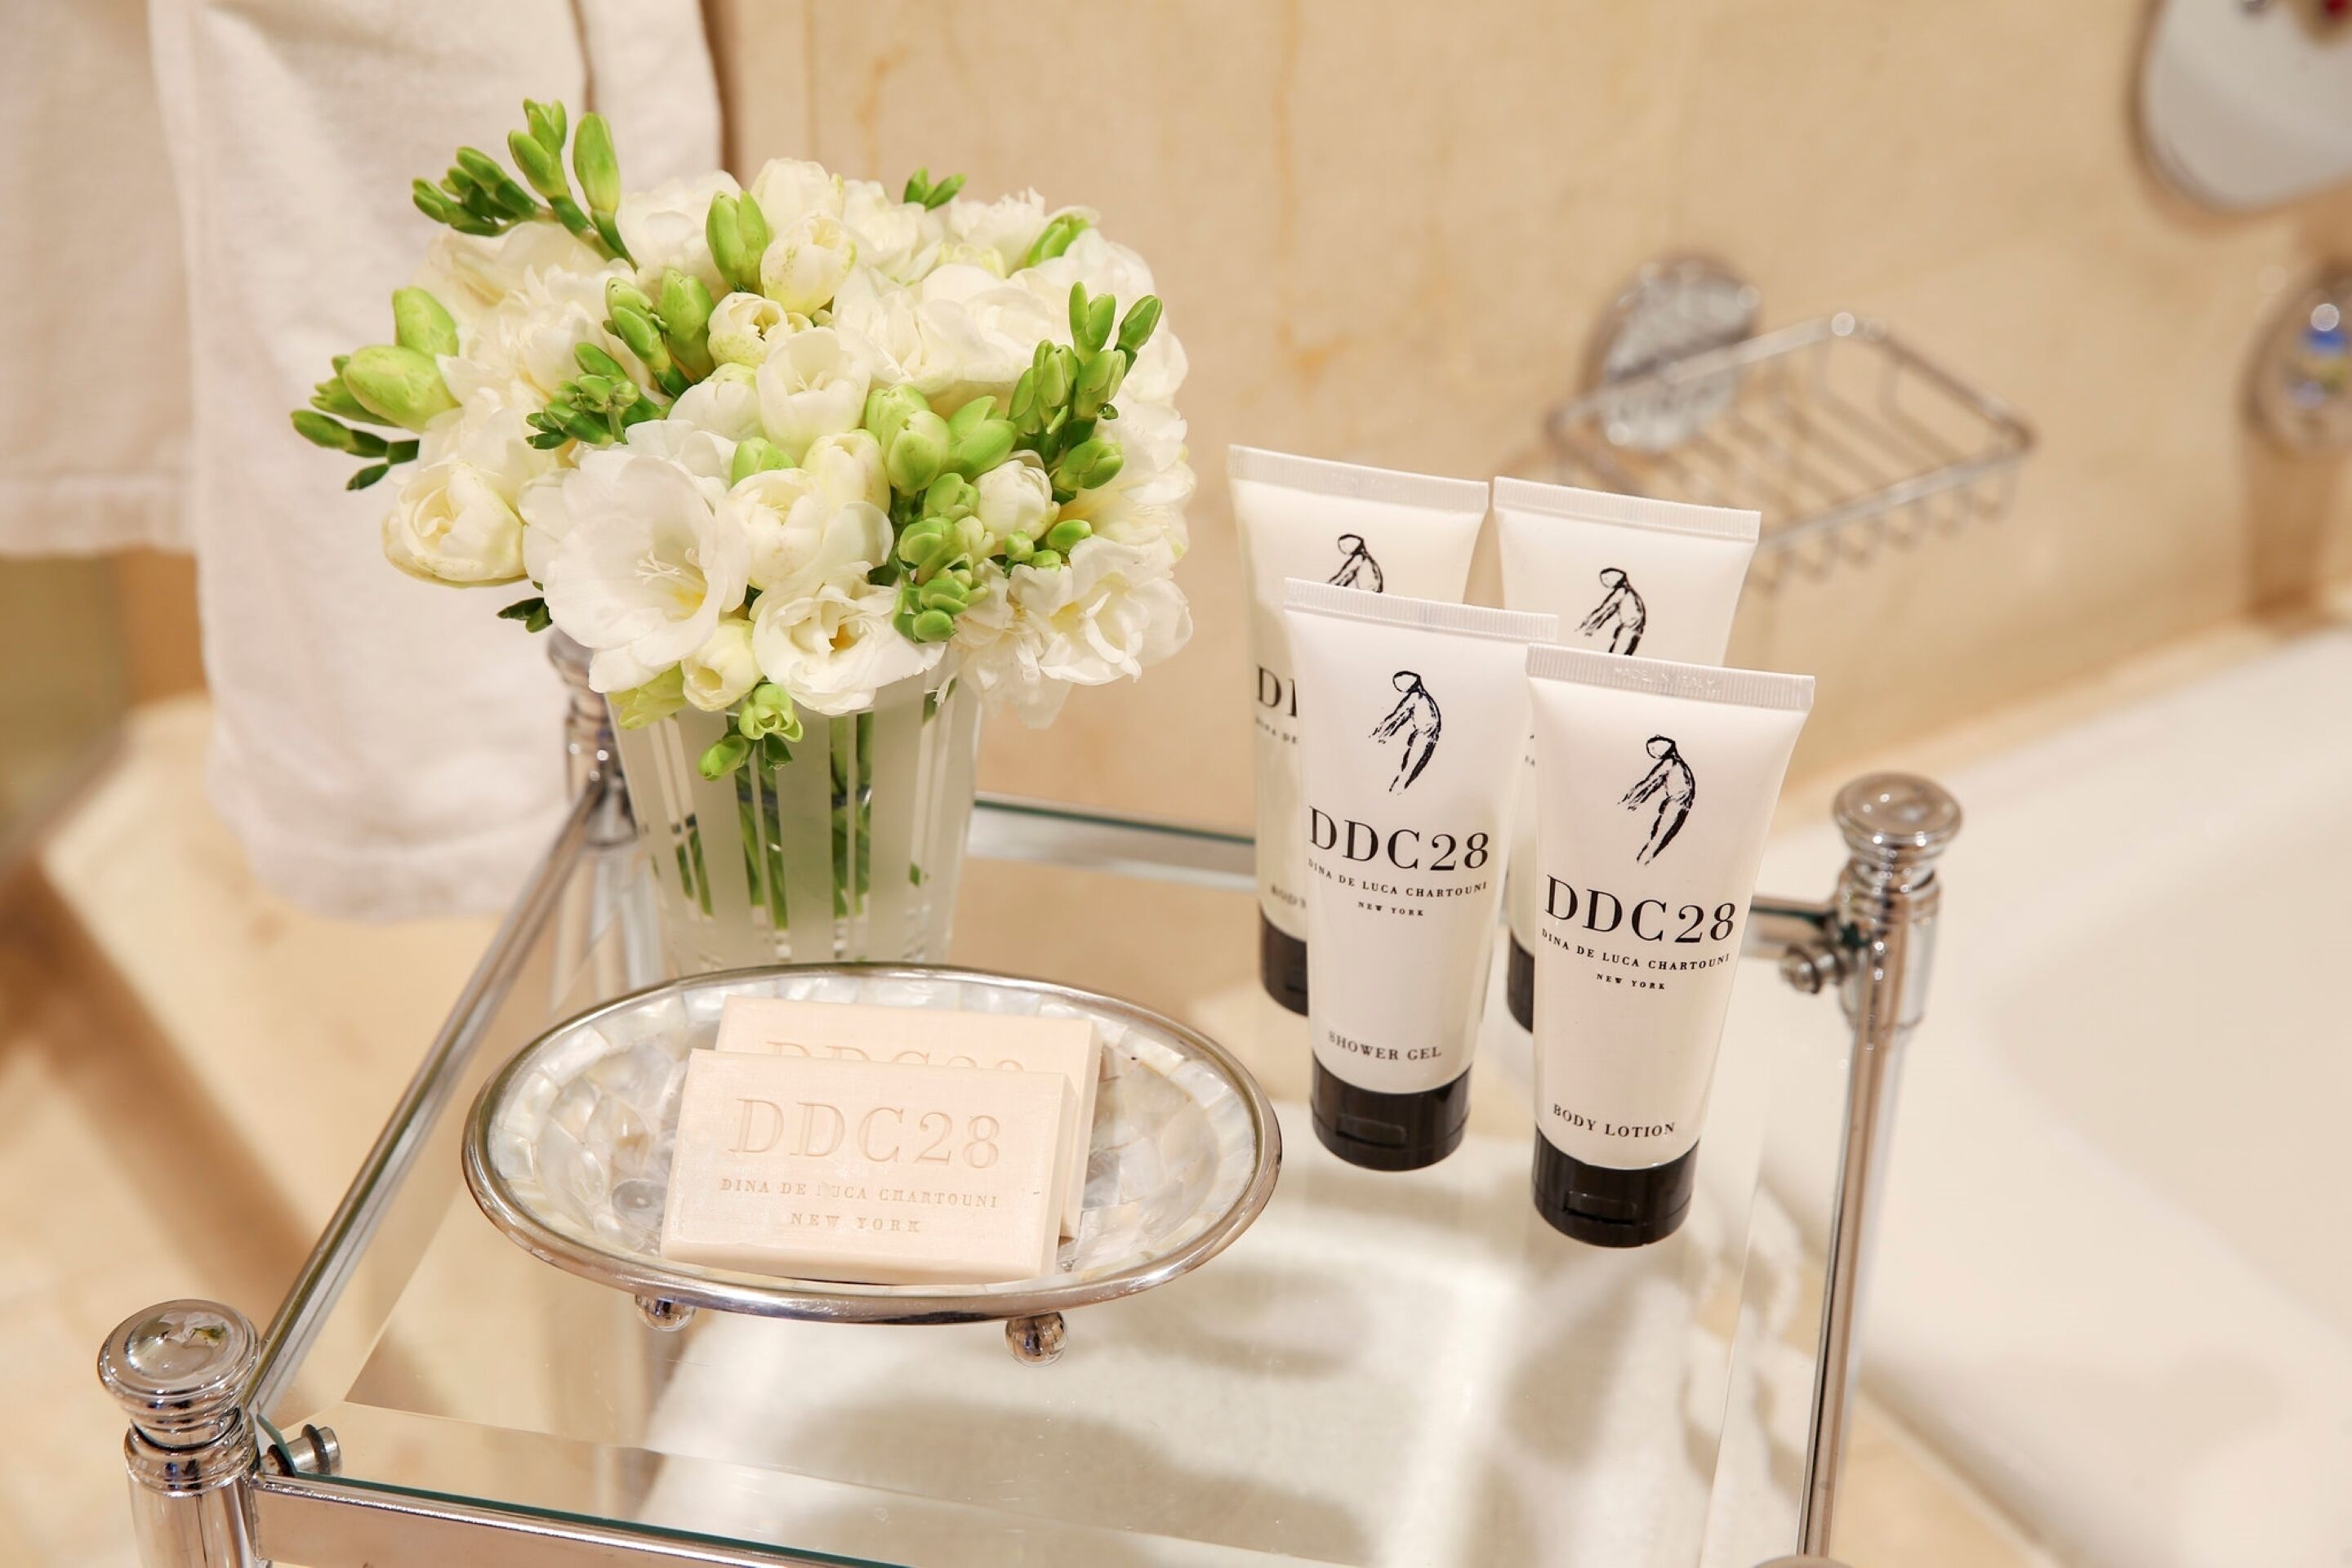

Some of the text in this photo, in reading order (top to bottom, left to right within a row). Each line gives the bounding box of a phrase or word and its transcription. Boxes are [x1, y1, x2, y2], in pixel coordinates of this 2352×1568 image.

[1309, 805, 1489, 871] DDC28
[1308, 858, 1487, 898] DINA DE LUCA CHARTOUNI
[1357, 901, 1424, 916] NEW YORK
[1544, 874, 1735, 943] DDC28
[1542, 928, 1730, 970] DINA DE LUCA CHARTOUNI
[1597, 973, 1665, 990] NEW YORK
[1328, 1031, 1441, 1061] SHOWER GEL
[728, 1098, 1001, 1169] DDC28
[1553, 1103, 1675, 1138] BODY LOTION
[719, 1178, 769, 1194] DINA
[780, 1182, 807, 1196] DE
[880, 1188, 999, 1209] CHARTOUNI
[790, 1213, 921, 1233] NEW YORK
